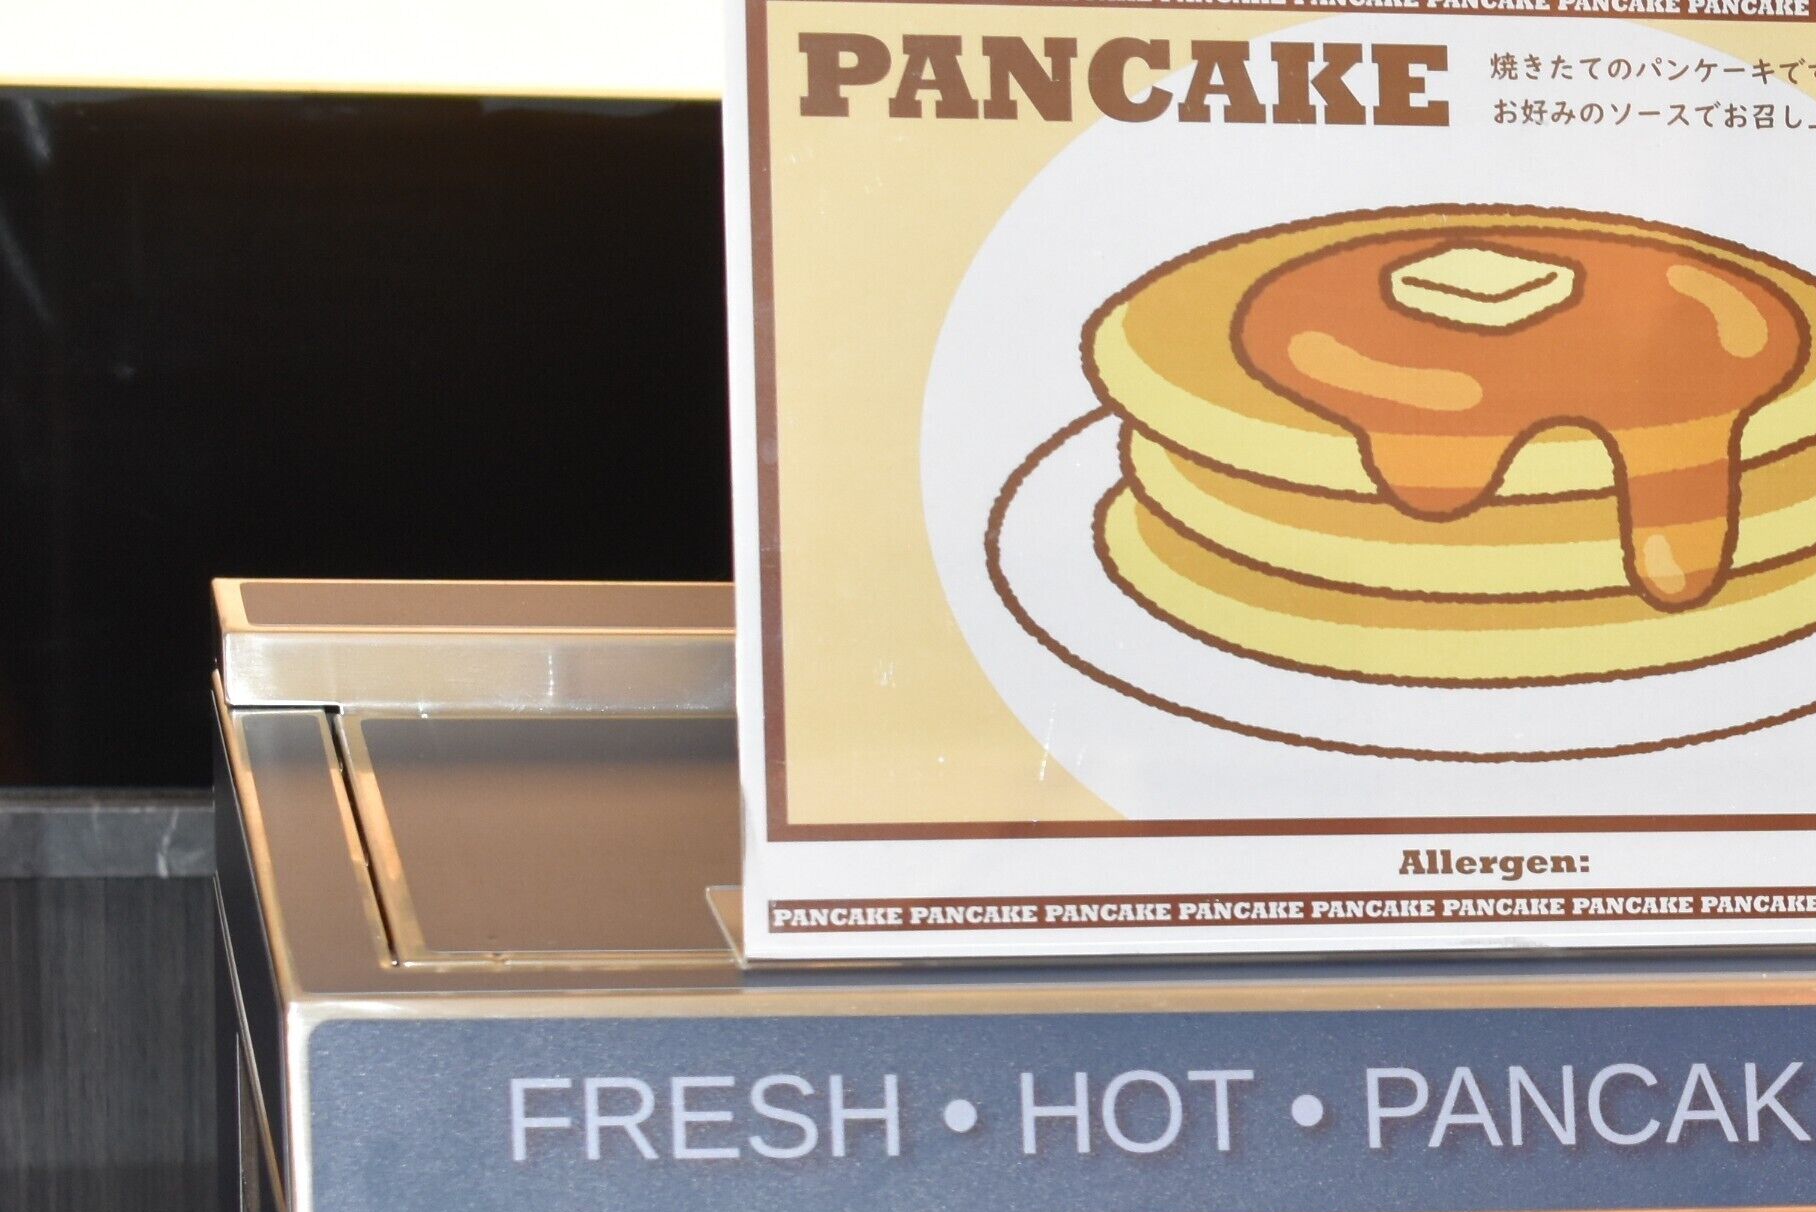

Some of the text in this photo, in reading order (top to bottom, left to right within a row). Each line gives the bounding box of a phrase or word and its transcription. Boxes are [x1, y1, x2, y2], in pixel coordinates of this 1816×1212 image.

[1557, 0, 1681, 14] PANCAKE
[1687, 0, 1810, 17] PANCAKE
[799, 32, 1451, 127] PANCAKE
[1400, 849, 1591, 880] Allergen:
[774, 905, 903, 927] PANCAKE
[910, 903, 1038, 925] PANCAKE
[1045, 902, 1172, 923] PANCAKE
[1178, 900, 1304, 921] PANCAKE
[1310, 899, 1436, 920] PANCAKE
[1442, 898, 1566, 917] PANCAKE
[1571, 896, 1695, 915] PANCAKE
[509, 1073, 901, 1163] FRESH
[1019, 1068, 1256, 1156] HOT
